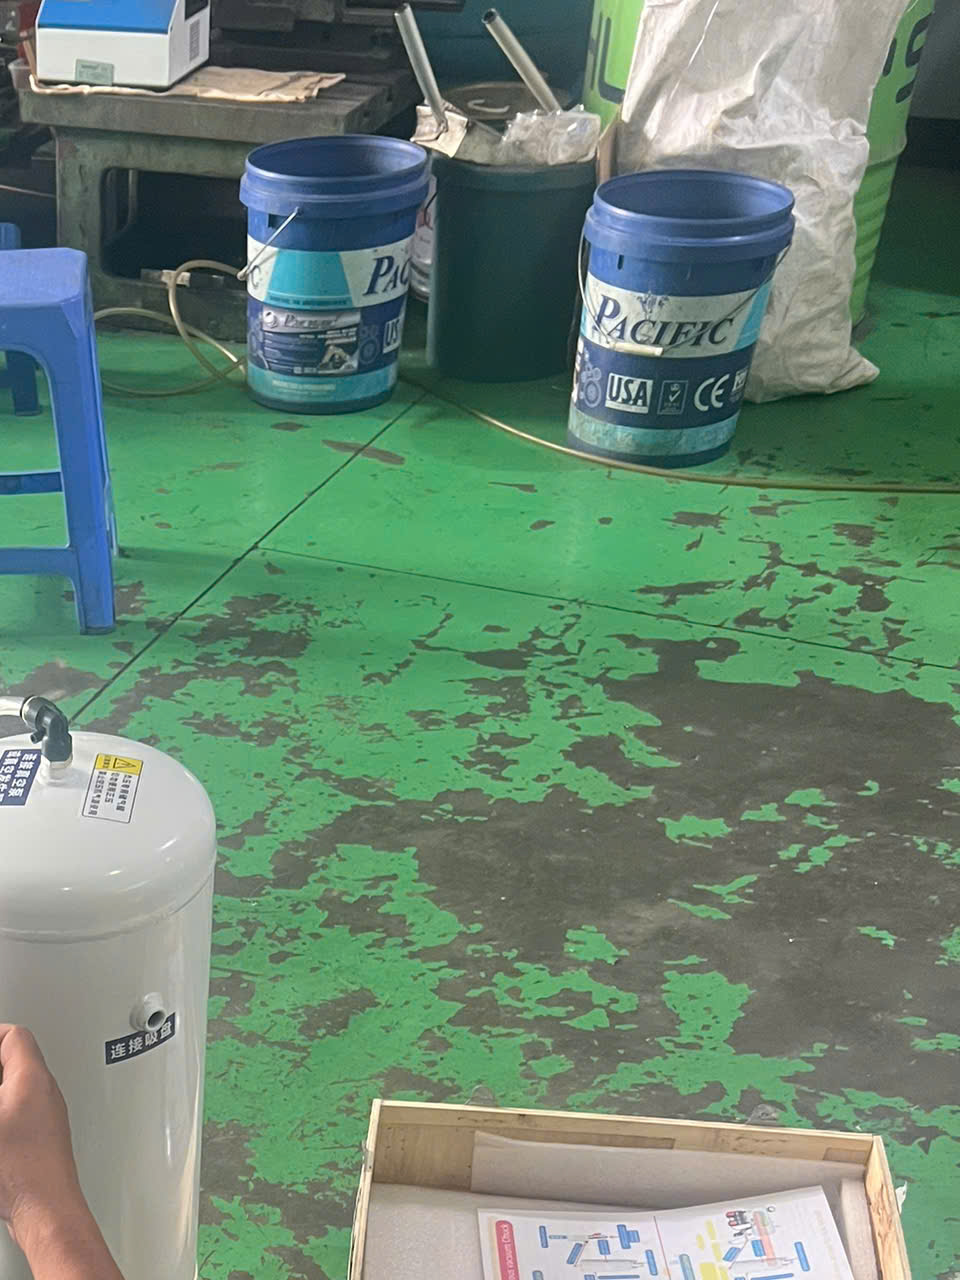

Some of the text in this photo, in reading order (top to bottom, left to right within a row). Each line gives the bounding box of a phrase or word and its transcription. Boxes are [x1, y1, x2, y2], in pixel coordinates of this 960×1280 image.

[592, 293, 735, 346] PACIFIC
[608, 374, 650, 407] USA
[694, 374, 730, 411] CE
[110, 1021, 172, 1060] 连接吸盘
[500, 1223, 512, 1243] Chuck
[503, 1244, 514, 1267] vacuum
